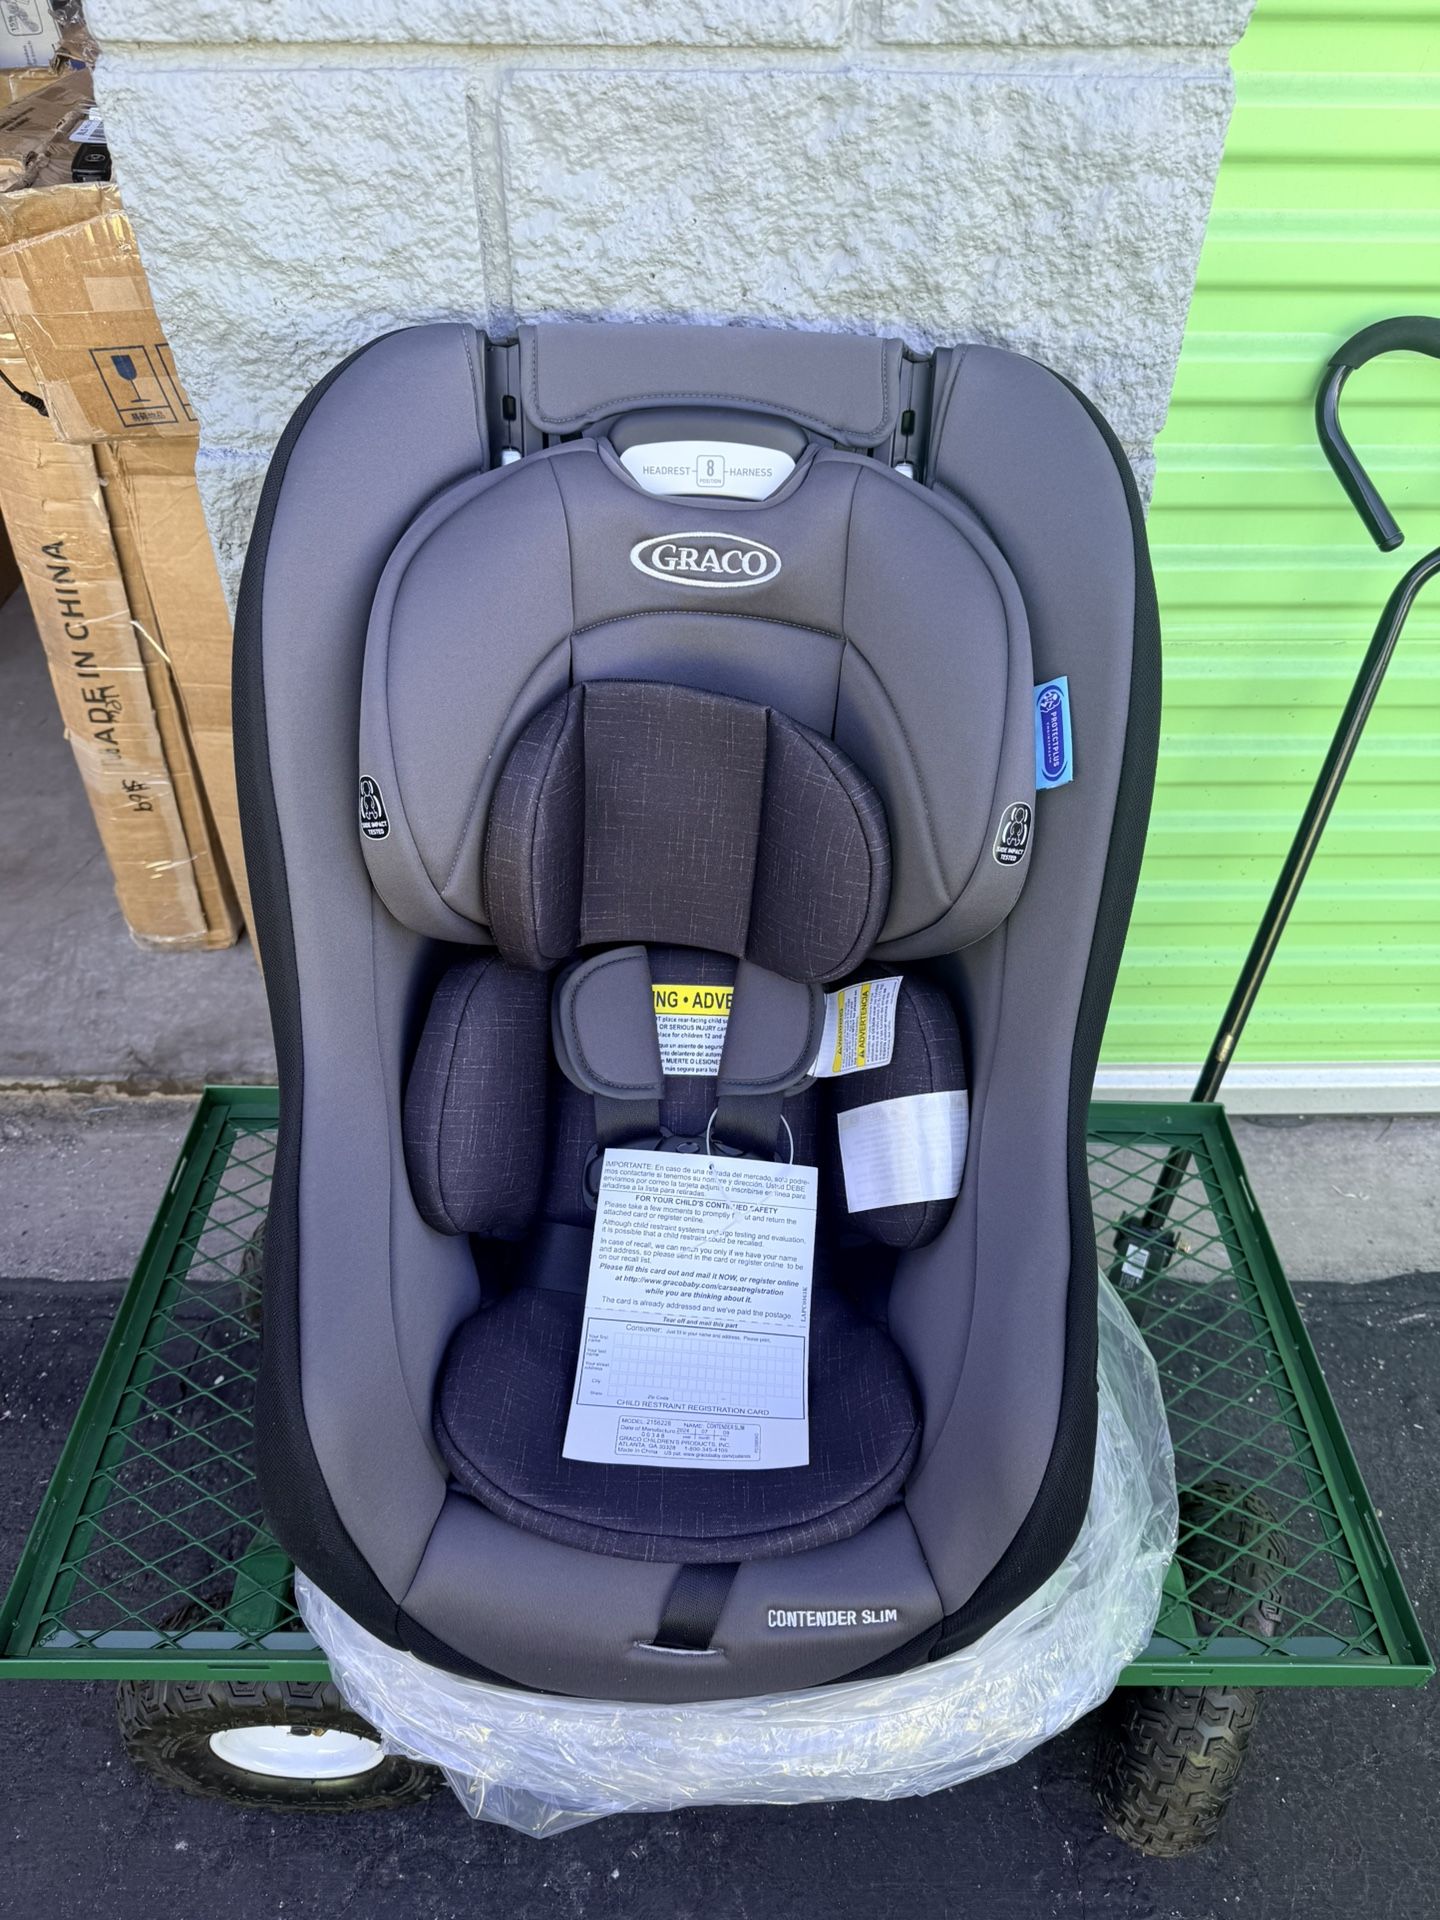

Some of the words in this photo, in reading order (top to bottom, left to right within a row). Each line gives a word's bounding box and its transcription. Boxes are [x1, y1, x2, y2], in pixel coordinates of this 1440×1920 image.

[643, 466, 690, 476] HEADREST
[706, 460, 714, 477] 8
[730, 468, 772, 477] HARNESS
[652, 544, 767, 576] GRACO
[42, 540, 90, 641] CHINA
[71, 651, 100, 678] IN
[1050, 711, 1060, 767] PROTECTPLUS
[664, 1173, 691, 1181] tenemos
[678, 1182, 699, 1190] tarjeta
[675, 1199, 704, 1207] CHILD'S
[603, 1208, 632, 1216] attached
[658, 1213, 682, 1222] register
[663, 1206, 693, 1215] moments
[703, 1210, 730, 1220] promptly
[602, 1218, 632, 1228] Although
[650, 1223, 676, 1231] restraint
[678, 1226, 705, 1235] systems
[735, 1231, 756, 1240] testing
[614, 1227, 642, 1237] possible
[680, 1233, 707, 1241] restraint
[653, 1250, 675, 1260] please
[738, 1258, 762, 1268] register
[713, 1248, 727, 1257] only
[599, 1263, 623, 1271] Please
[719, 1274, 738, 1282] NOW,
[749, 1276, 775, 1286] register
[693, 1292, 722, 1302] thinking
[640, 1300, 664, 1309] already
[666, 1302, 701, 1311] addressed
[737, 1308, 751, 1317] paid
[642, 1401, 686, 1410] RESTRAINT
[687, 1404, 746, 1414] REGISTRATION
[768, 1609, 857, 1628] CONTENDER
[862, 1608, 897, 1624] SLIM
